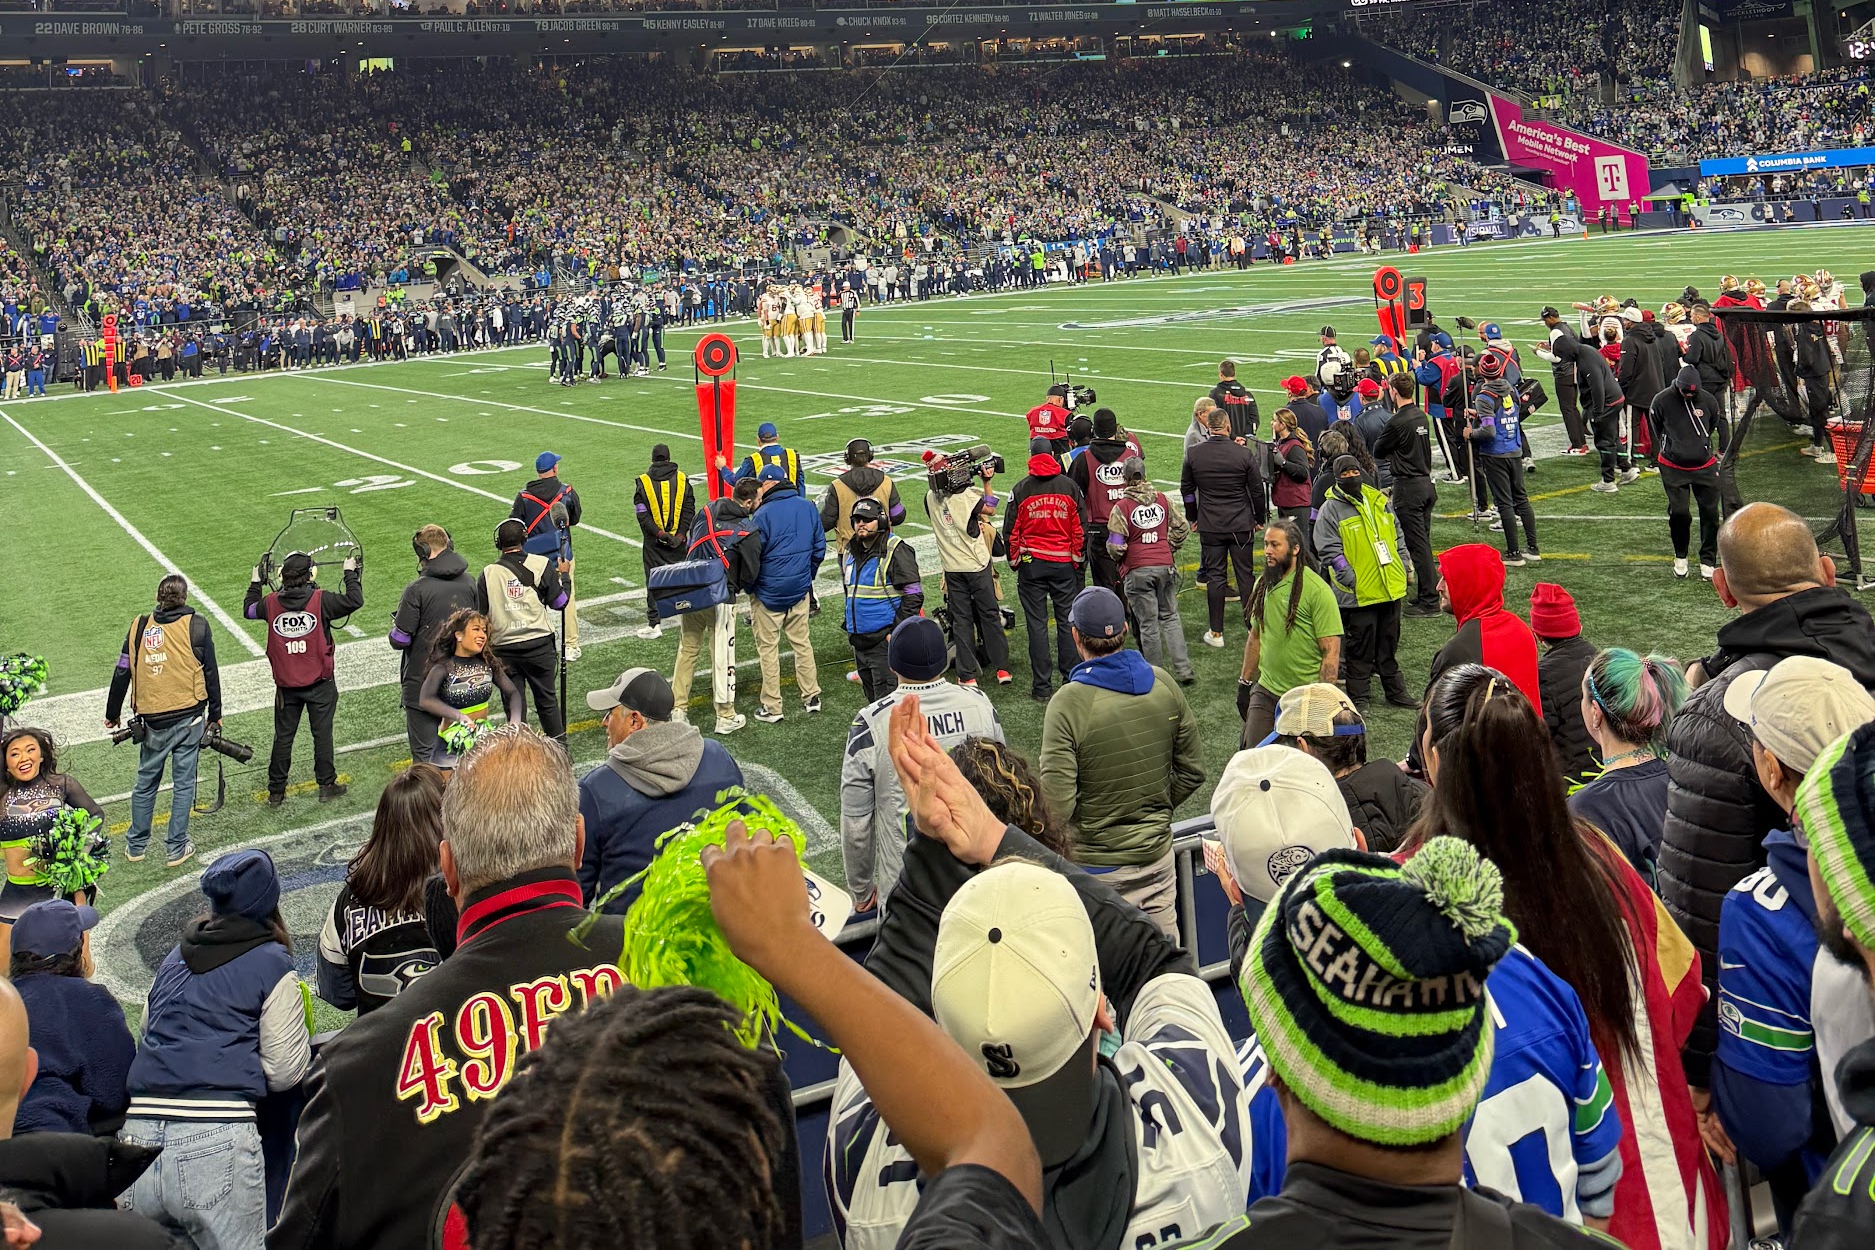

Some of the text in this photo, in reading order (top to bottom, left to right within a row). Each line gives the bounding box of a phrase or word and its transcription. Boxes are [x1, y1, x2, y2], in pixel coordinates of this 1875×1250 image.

[1028, 10, 1084, 22] 71 WALTER JONES
[1153, 6, 1209, 18] MATT HASSELBECK
[1727, 6, 1775, 17] MUCKLESHOOT
[643, 19, 709, 30] 45 KENNY EASLEY
[747, 17, 800, 28] 17 DAVE KRIEG
[848, 16, 892, 26] CHUCK KNOX
[926, 13, 994, 24] 96 CORTEZ KENNEDY
[35, 22, 143, 35] 22 DAVE BROWN 76-86
[182, 23, 262, 35] PETE GROSS 76-92
[291, 22, 393, 34] 28 CURT WARNER 83-89
[434, 21, 456, 33] PAUL
[457, 22, 465, 32] G.
[467, 21, 491, 32] ALLEN
[535, 21, 549, 31] 79
[549, 21, 574, 31] JACOB
[576, 20, 601, 31] GREEN
[1508, 119, 1591, 156] America's Best
[1438, 145, 1473, 155] UMEN
[1517, 134, 1544, 151] Mobile
[1543, 143, 1579, 163] Network
[1759, 155, 1827, 168] COLUMBIA BANK
[378, 296, 387, 307] 3
[1409, 282, 1425, 310] 3
[131, 375, 142, 385] 20
[1104, 466, 1123, 477] FOX
[1107, 488, 1124, 501] 105
[1026, 496, 1055, 512] SEATTLE
[1028, 510, 1051, 520] MEDIC
[1138, 507, 1158, 519] FOX
[1140, 517, 1160, 525] SPORTS
[1141, 532, 1158, 544] 106
[508, 587, 522, 597] NFL
[504, 602, 529, 611] MEDIA
[282, 615, 307, 627] FOX
[144, 633, 163, 647] NFL
[285, 640, 307, 655] 109
[145, 652, 168, 664] MEDIA
[152, 664, 164, 676] 97
[929, 711, 965, 736] NCH
